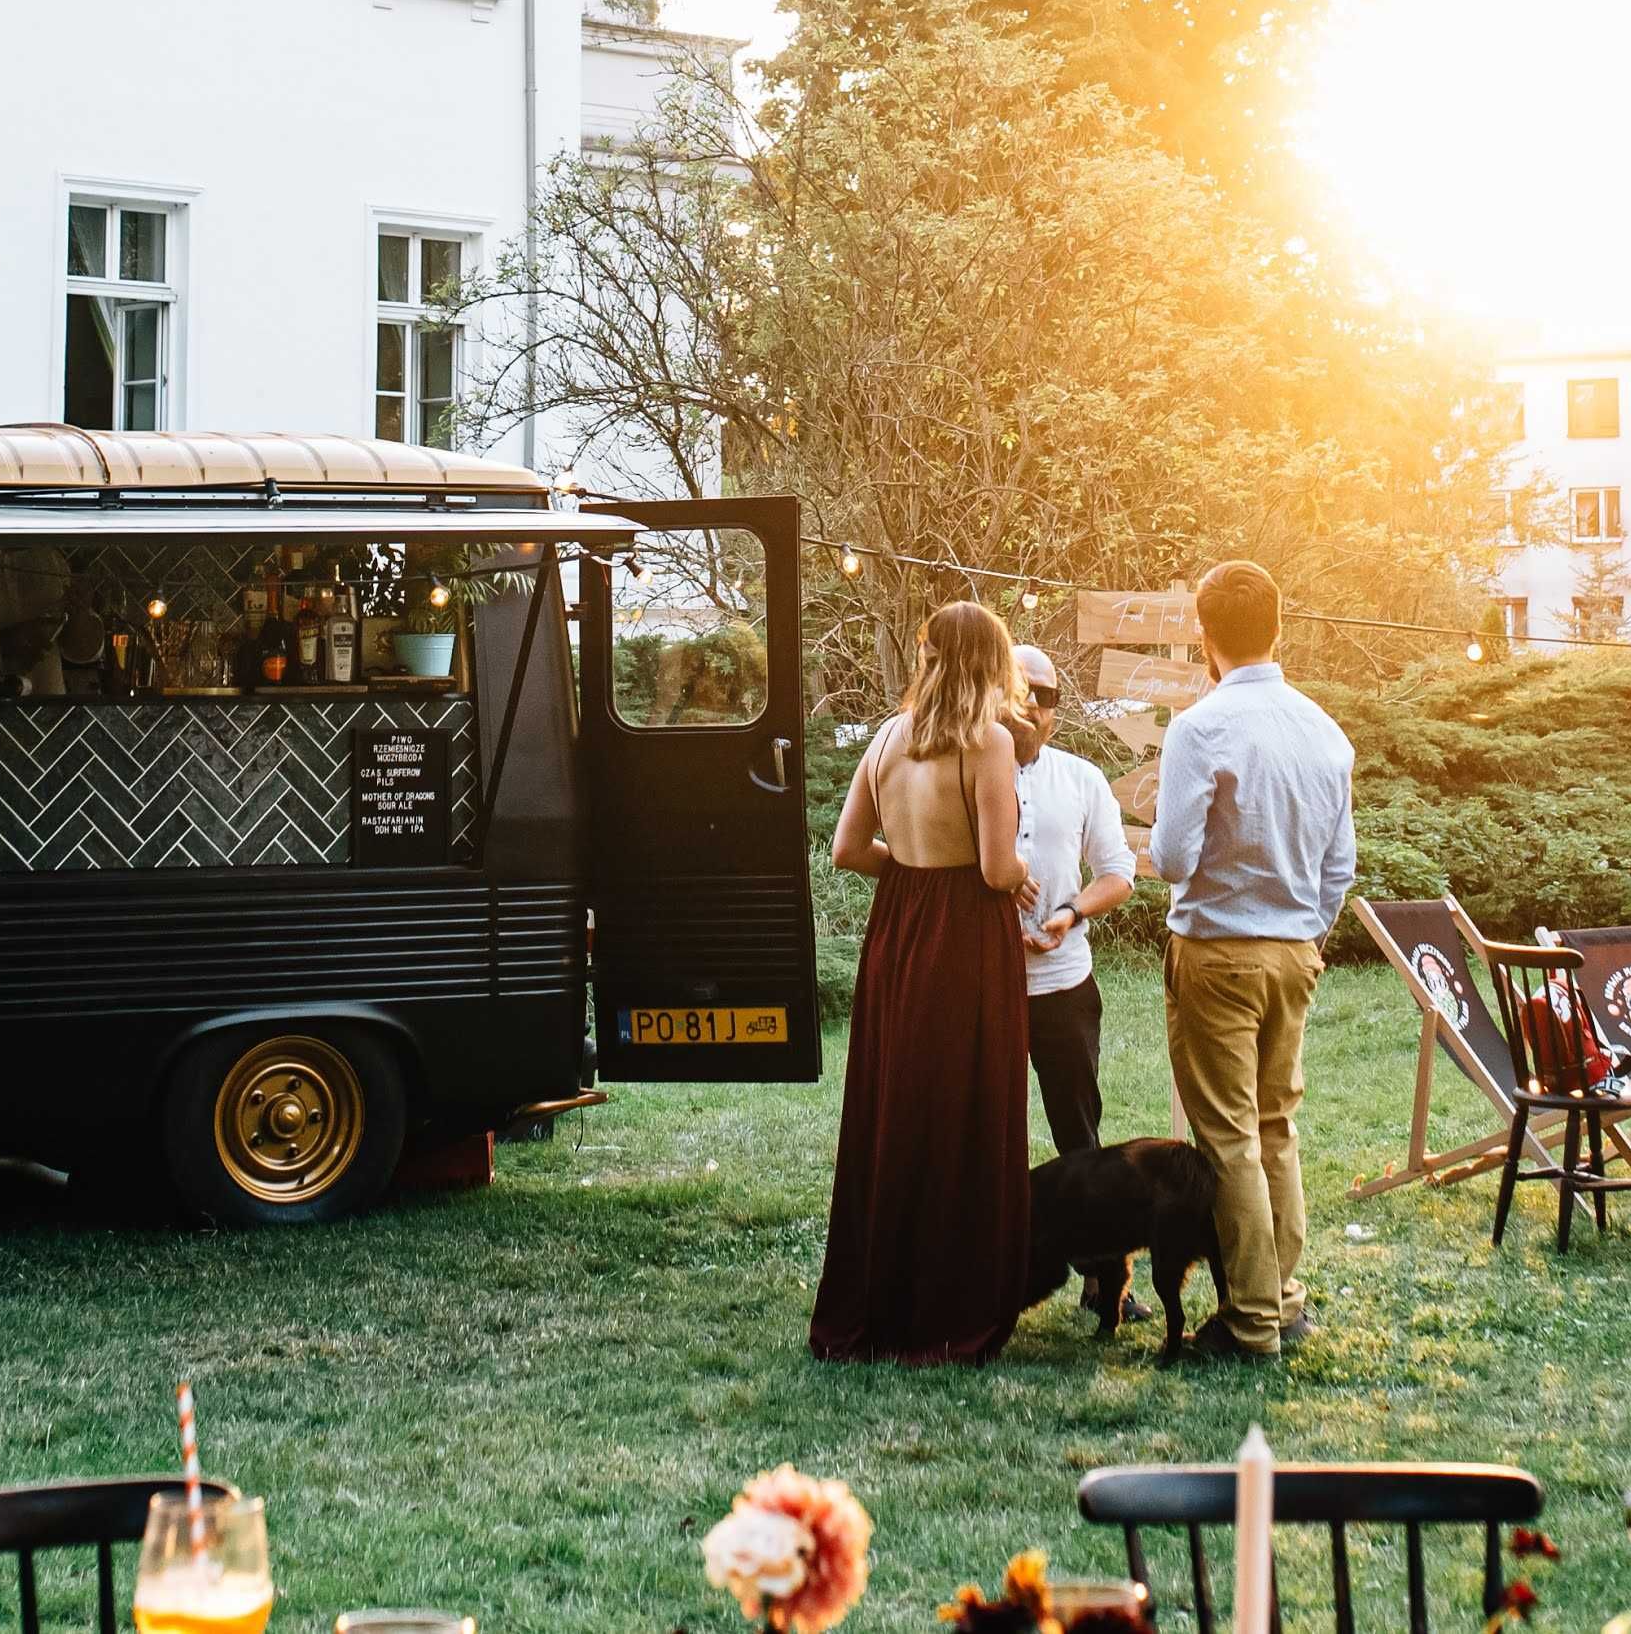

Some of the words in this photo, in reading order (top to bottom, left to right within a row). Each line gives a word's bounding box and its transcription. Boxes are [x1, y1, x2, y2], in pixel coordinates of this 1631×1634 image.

[391, 735, 413, 744] PIWO
[376, 753, 423, 762] MOCZYBRODA
[360, 768, 382, 778] CZAS
[376, 777, 394, 787] PILS
[361, 792, 393, 802] MOTHER
[393, 792, 404, 801] OF
[405, 791, 435, 801] DRAGONS
[377, 801, 397, 811] SOUR
[398, 800, 413, 810] ALE
[361, 815, 424, 826] RASTAFARIANIN
[392, 825, 403, 834] NE
[410, 824, 425, 834] IPA
[636, 1011, 674, 1042] PO
[685, 1011, 736, 1041] 81J
